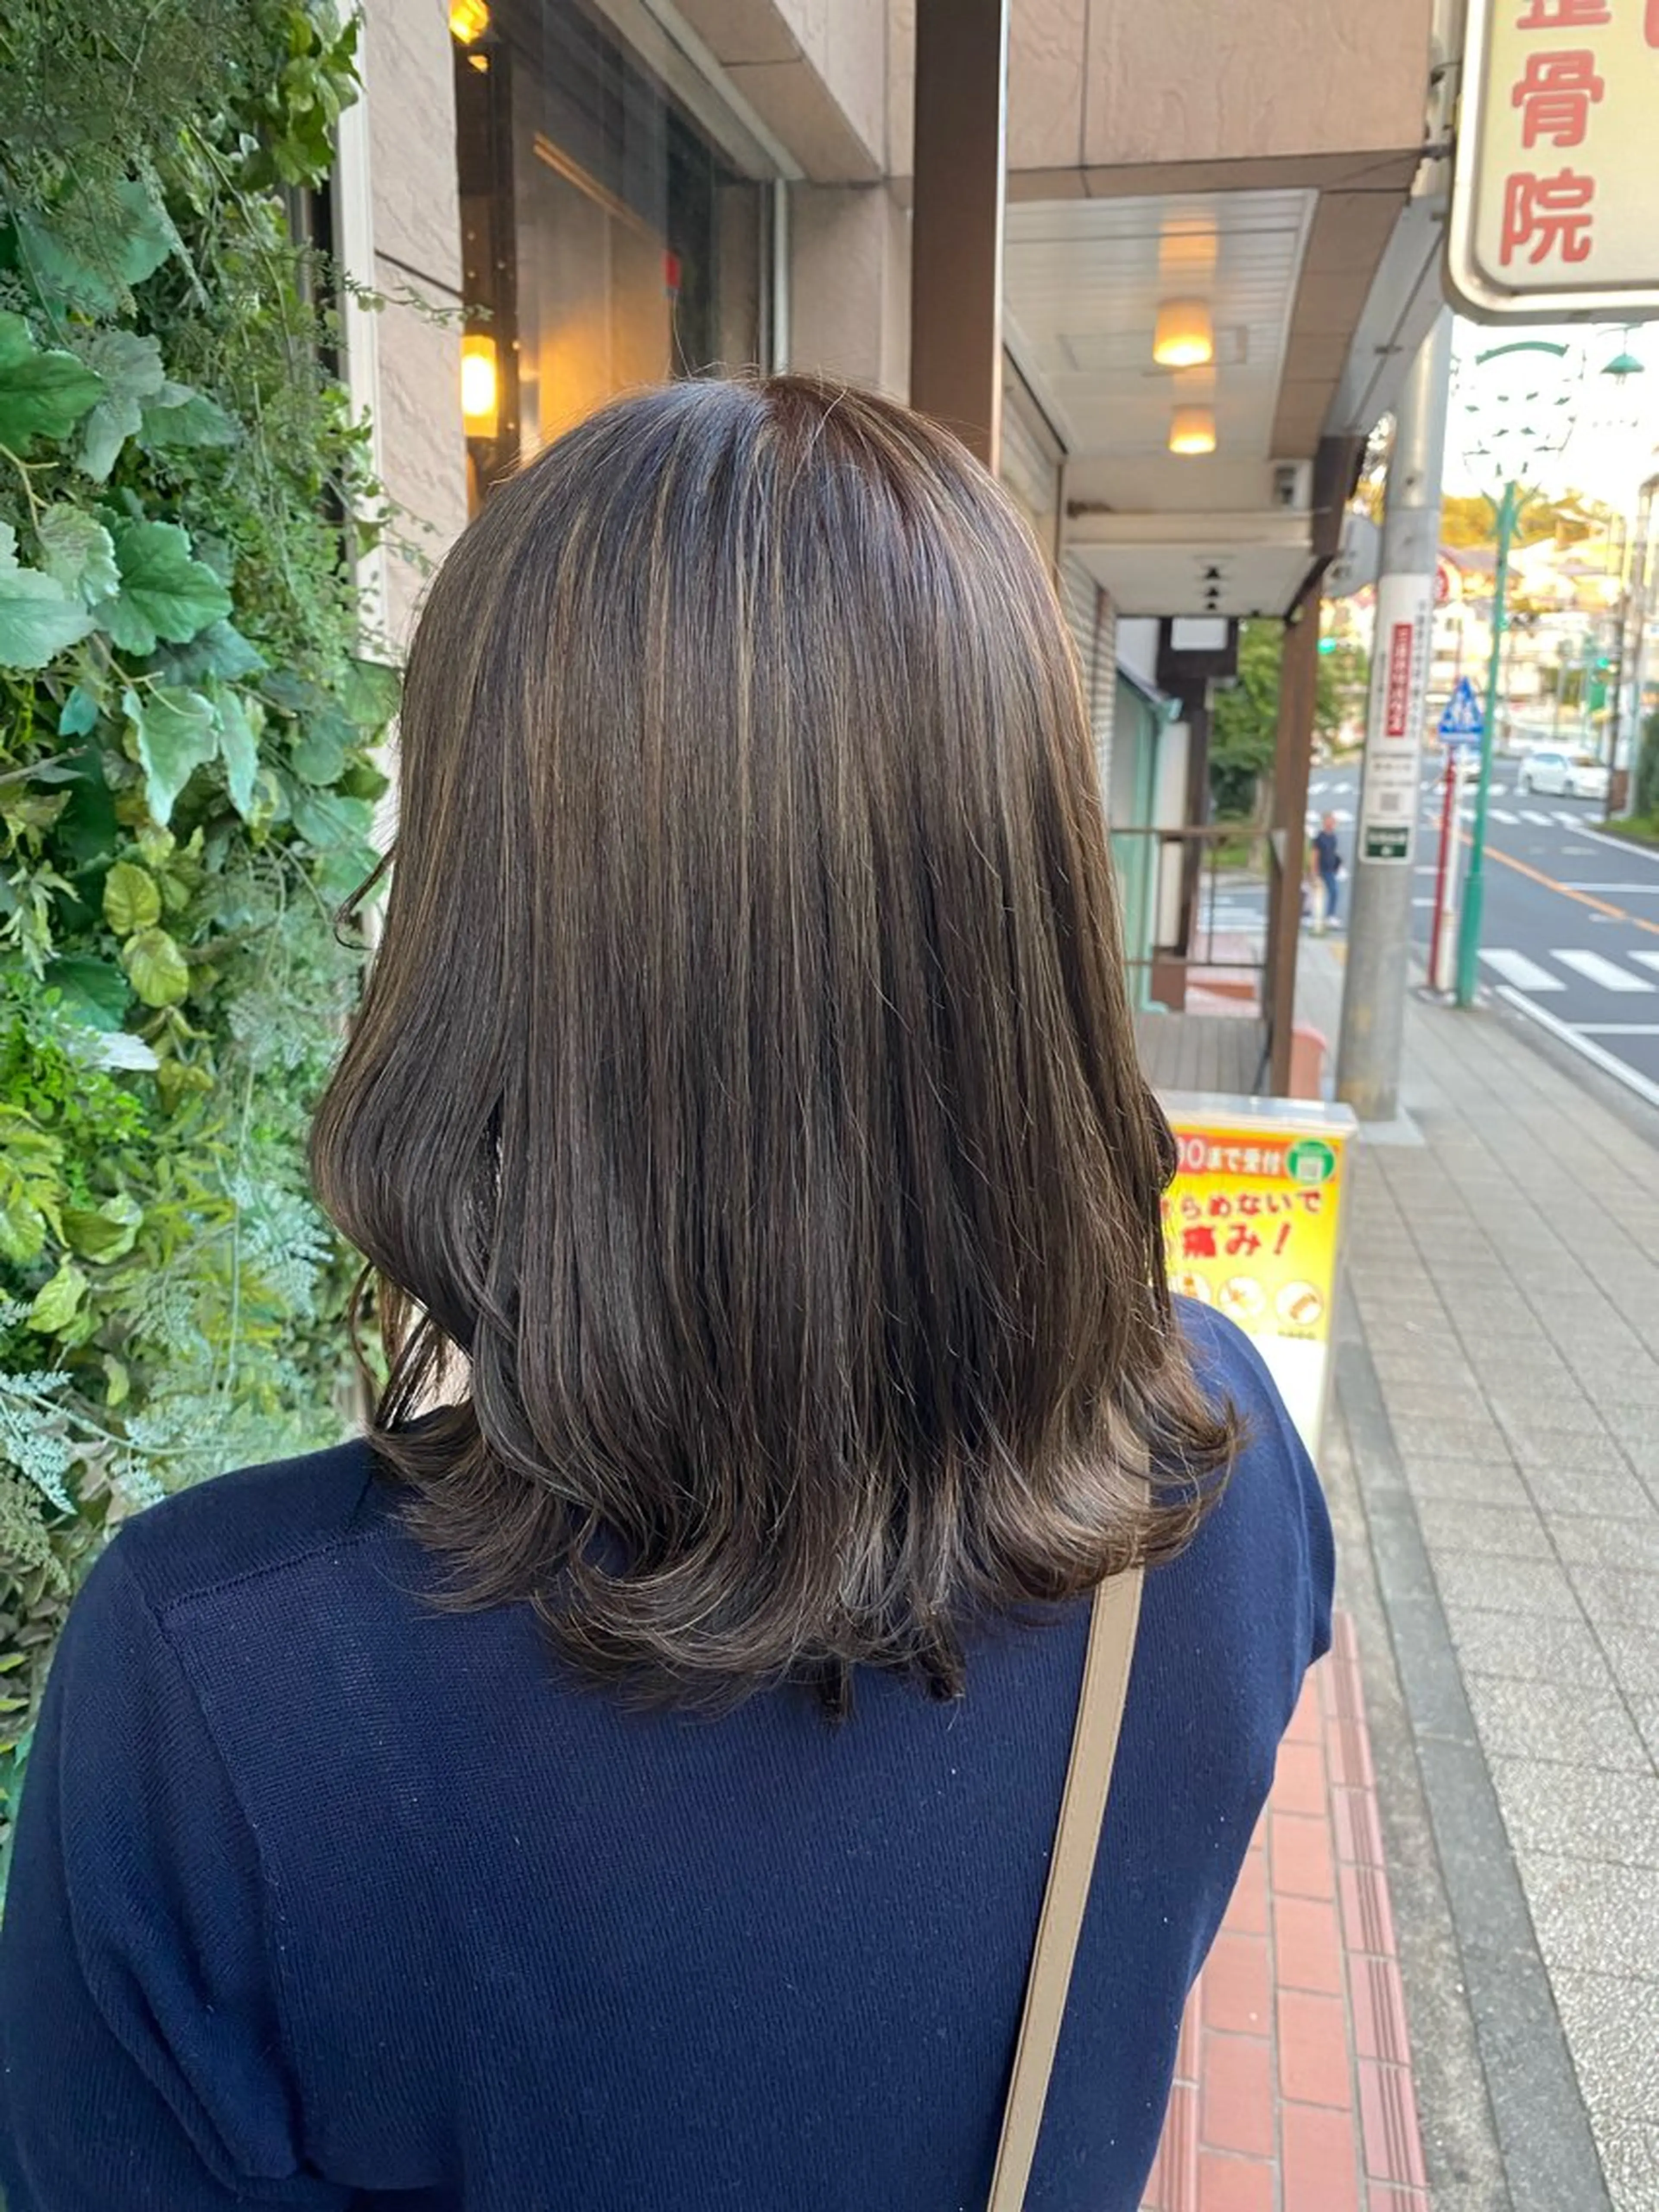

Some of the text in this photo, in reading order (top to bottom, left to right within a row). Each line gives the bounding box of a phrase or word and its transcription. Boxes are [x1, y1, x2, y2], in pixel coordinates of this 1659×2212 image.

[1161, 1190, 1322, 1220] らめないで
